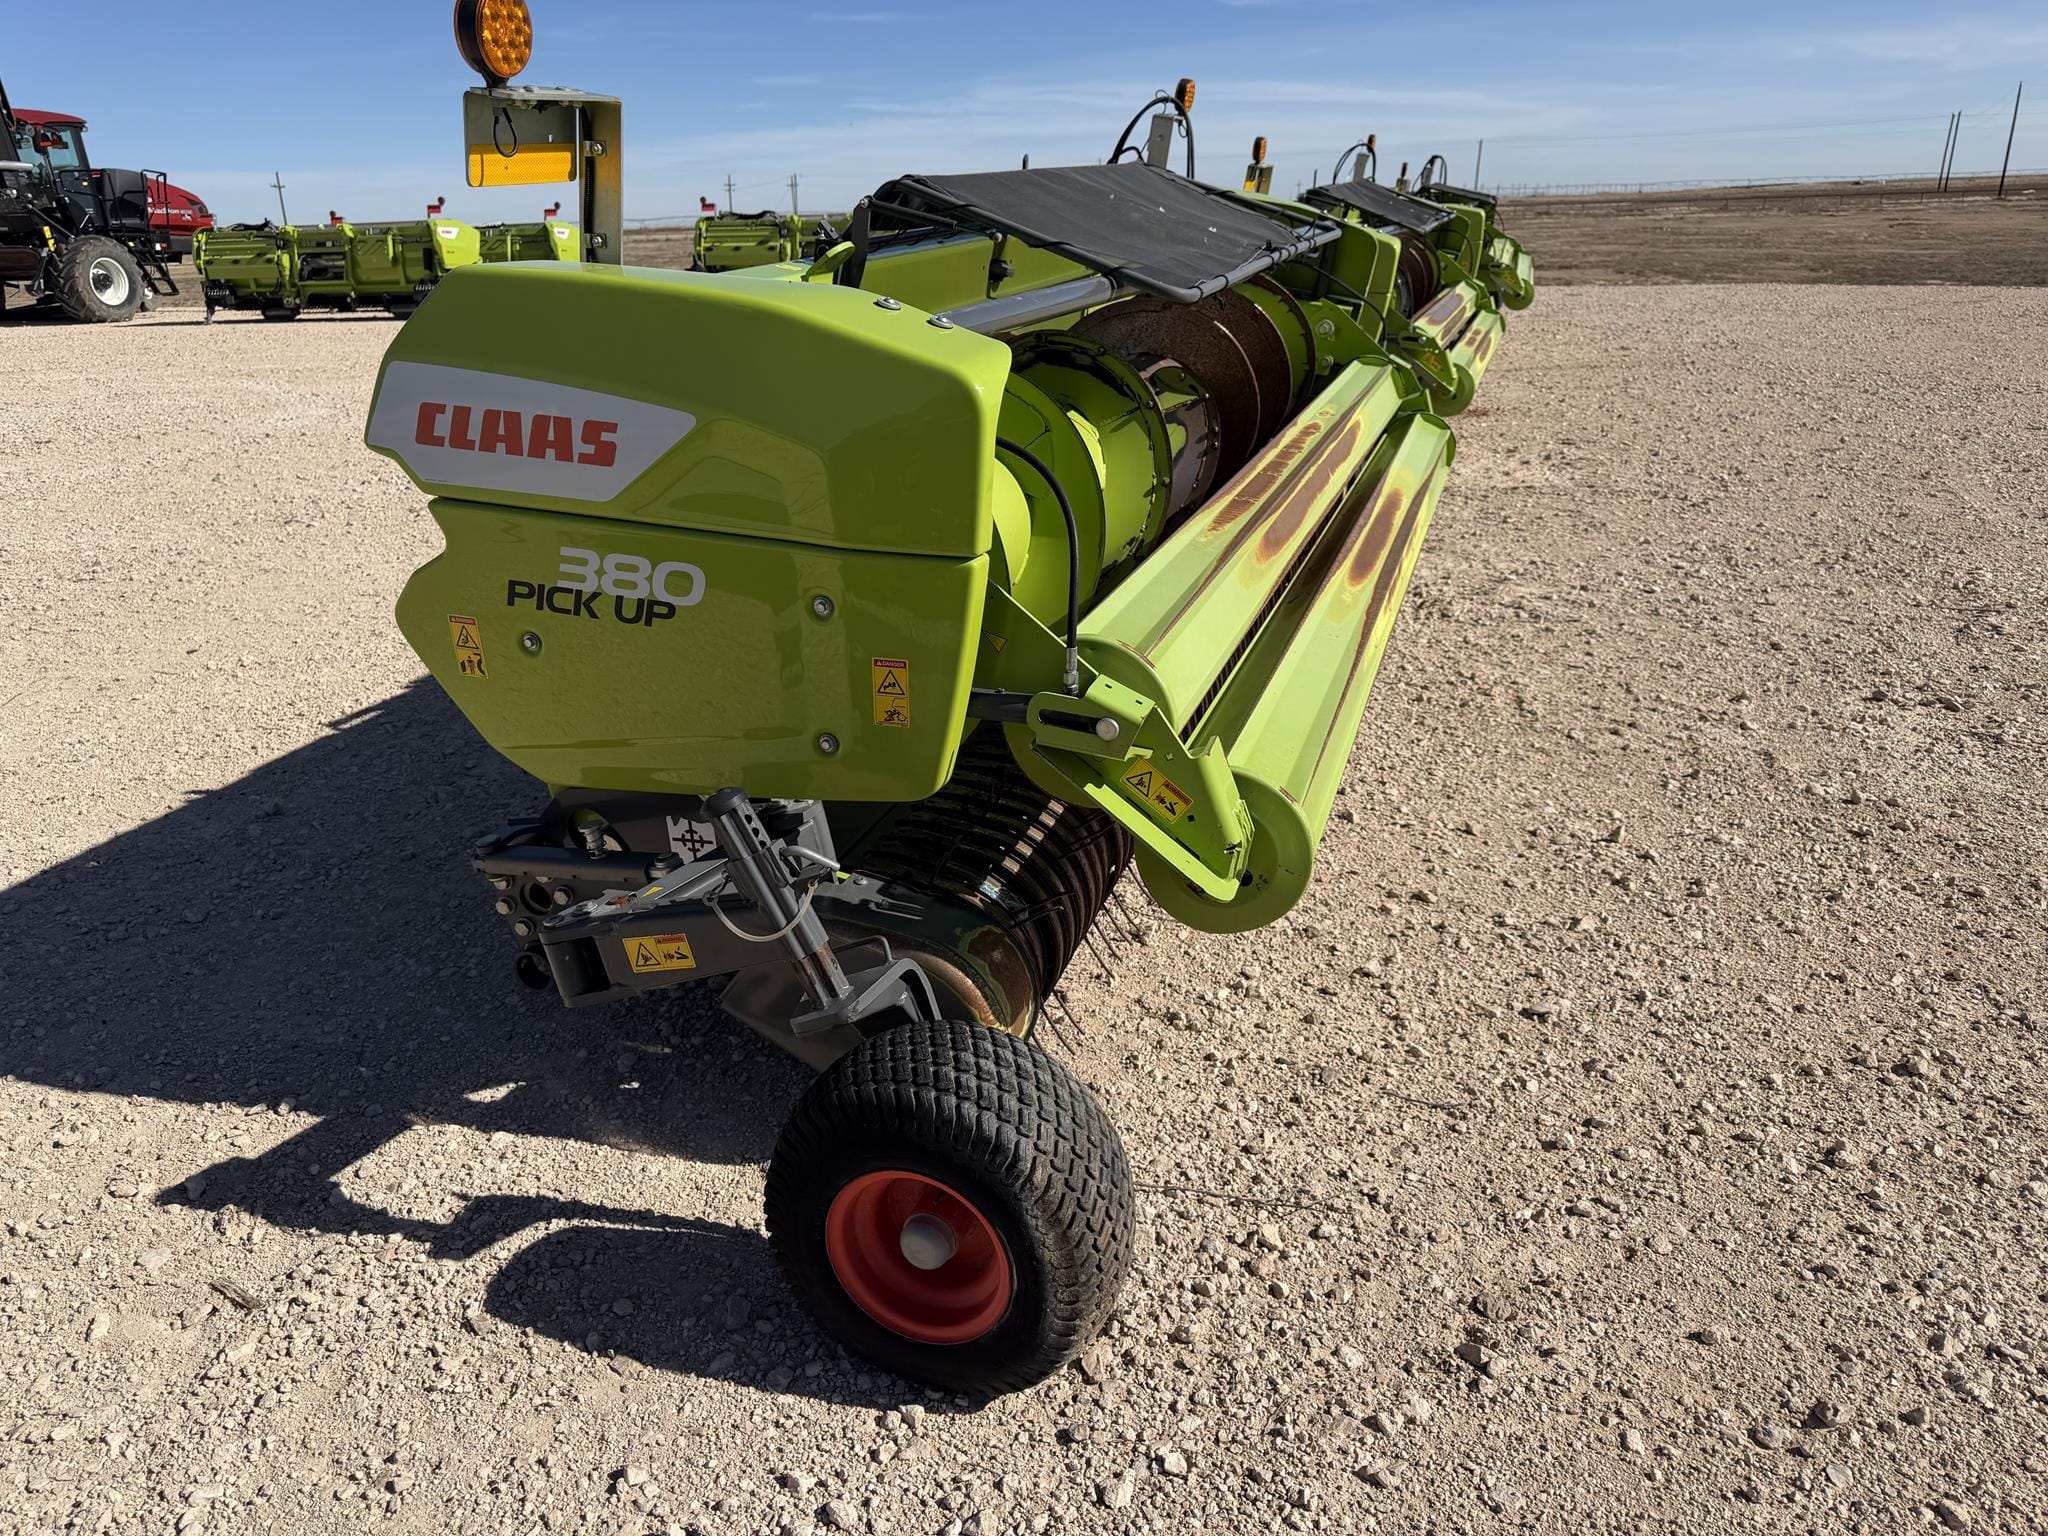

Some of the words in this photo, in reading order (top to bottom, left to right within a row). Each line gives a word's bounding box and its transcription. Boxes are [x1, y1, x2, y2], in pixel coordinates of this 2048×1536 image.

[414, 401, 619, 468] CLAAS
[507, 579, 603, 620] PICK
[614, 594, 677, 628] UP
[556, 546, 706, 607] 380
